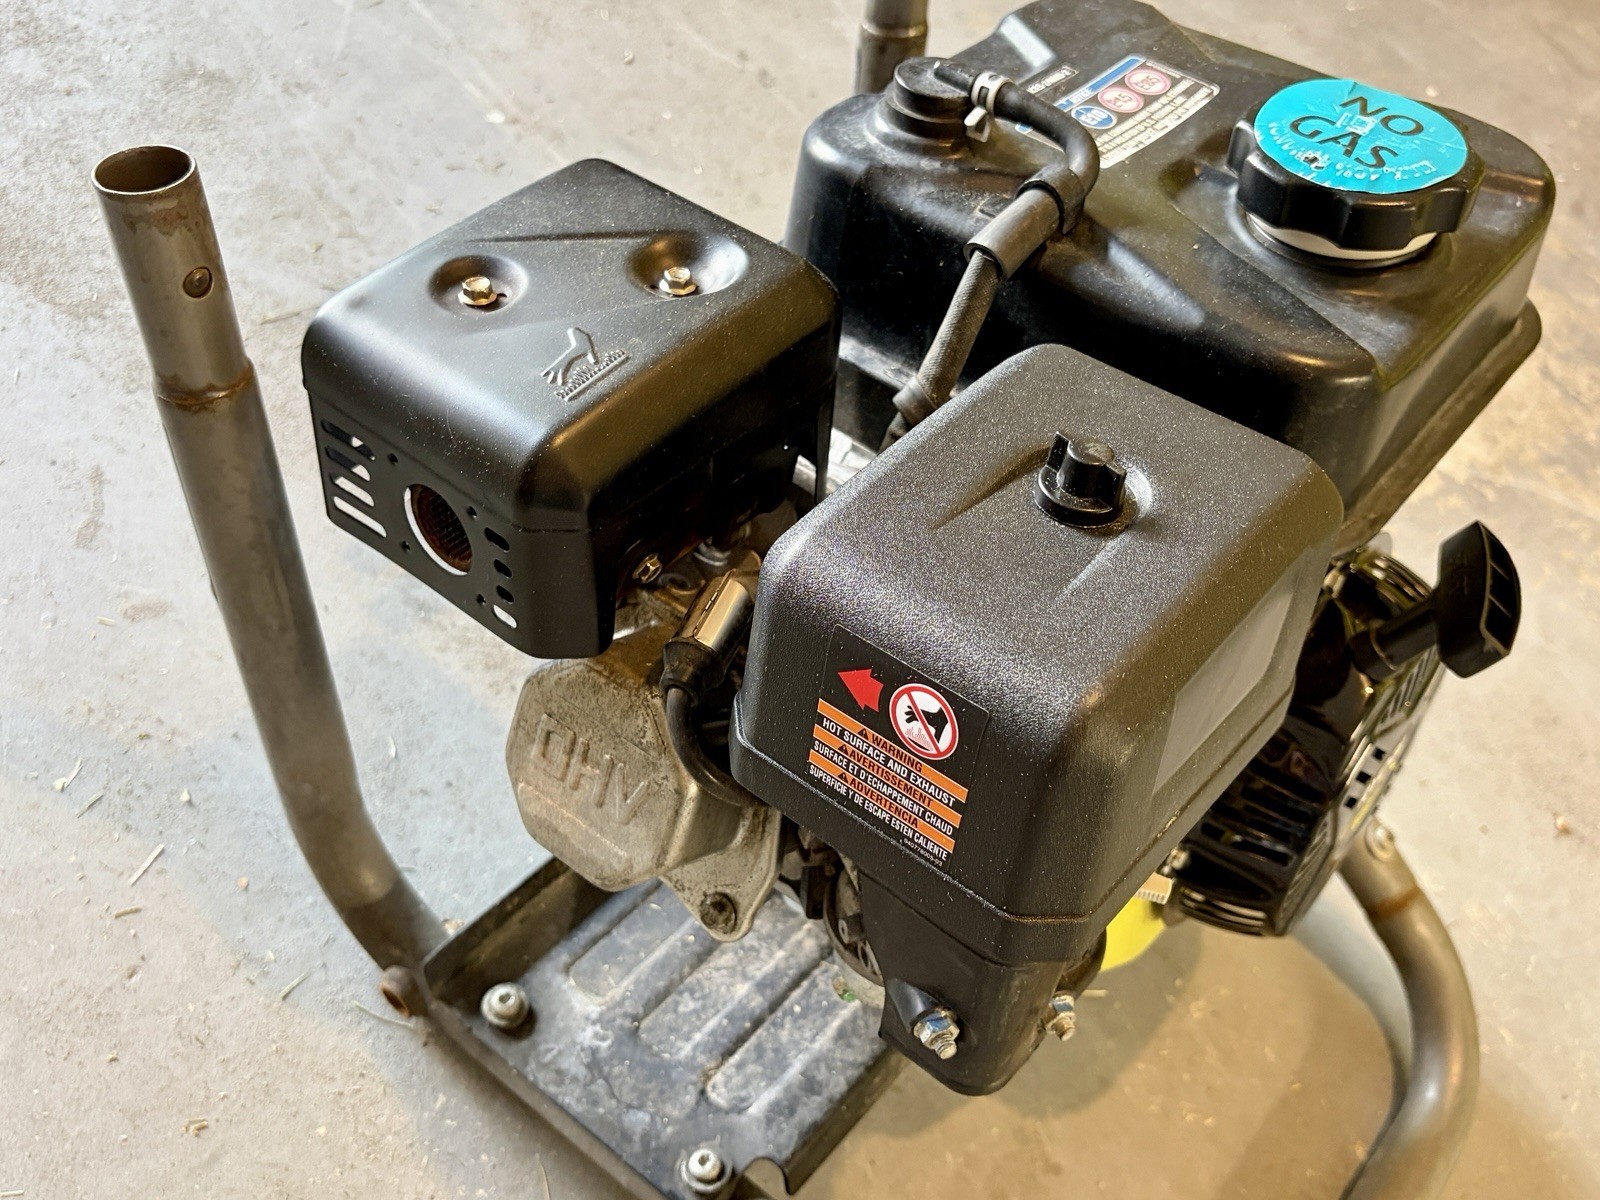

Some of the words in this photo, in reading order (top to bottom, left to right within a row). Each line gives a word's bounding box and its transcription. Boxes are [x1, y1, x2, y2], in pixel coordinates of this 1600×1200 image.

[1289, 115, 1399, 169] GAS
[1340, 96, 1424, 136] NO
[532, 713, 651, 825] OHV
[823, 718, 842, 736] HOT
[843, 730, 886, 764] SURFACE
[887, 759, 912, 778] AND
[910, 772, 956, 807] EXHAUST
[849, 750, 933, 808] AVERTISSEMENT
[872, 733, 923, 772] WARNING
[809, 765, 847, 796] SUPERFICIE
[848, 790, 853, 799] Y
[854, 794, 864, 805] DE
[864, 800, 891, 824] ESCAPE
[891, 819, 913, 838] ESTEN
[914, 832, 948, 860] CALIENTE
[814, 741, 847, 768] SURFACE
[848, 763, 859, 776] ET
[860, 771, 923, 816] D'ECHAPPEMENT
[925, 811, 953, 835] CHAUD
[850, 780, 919, 828] ADVERTENCIA
